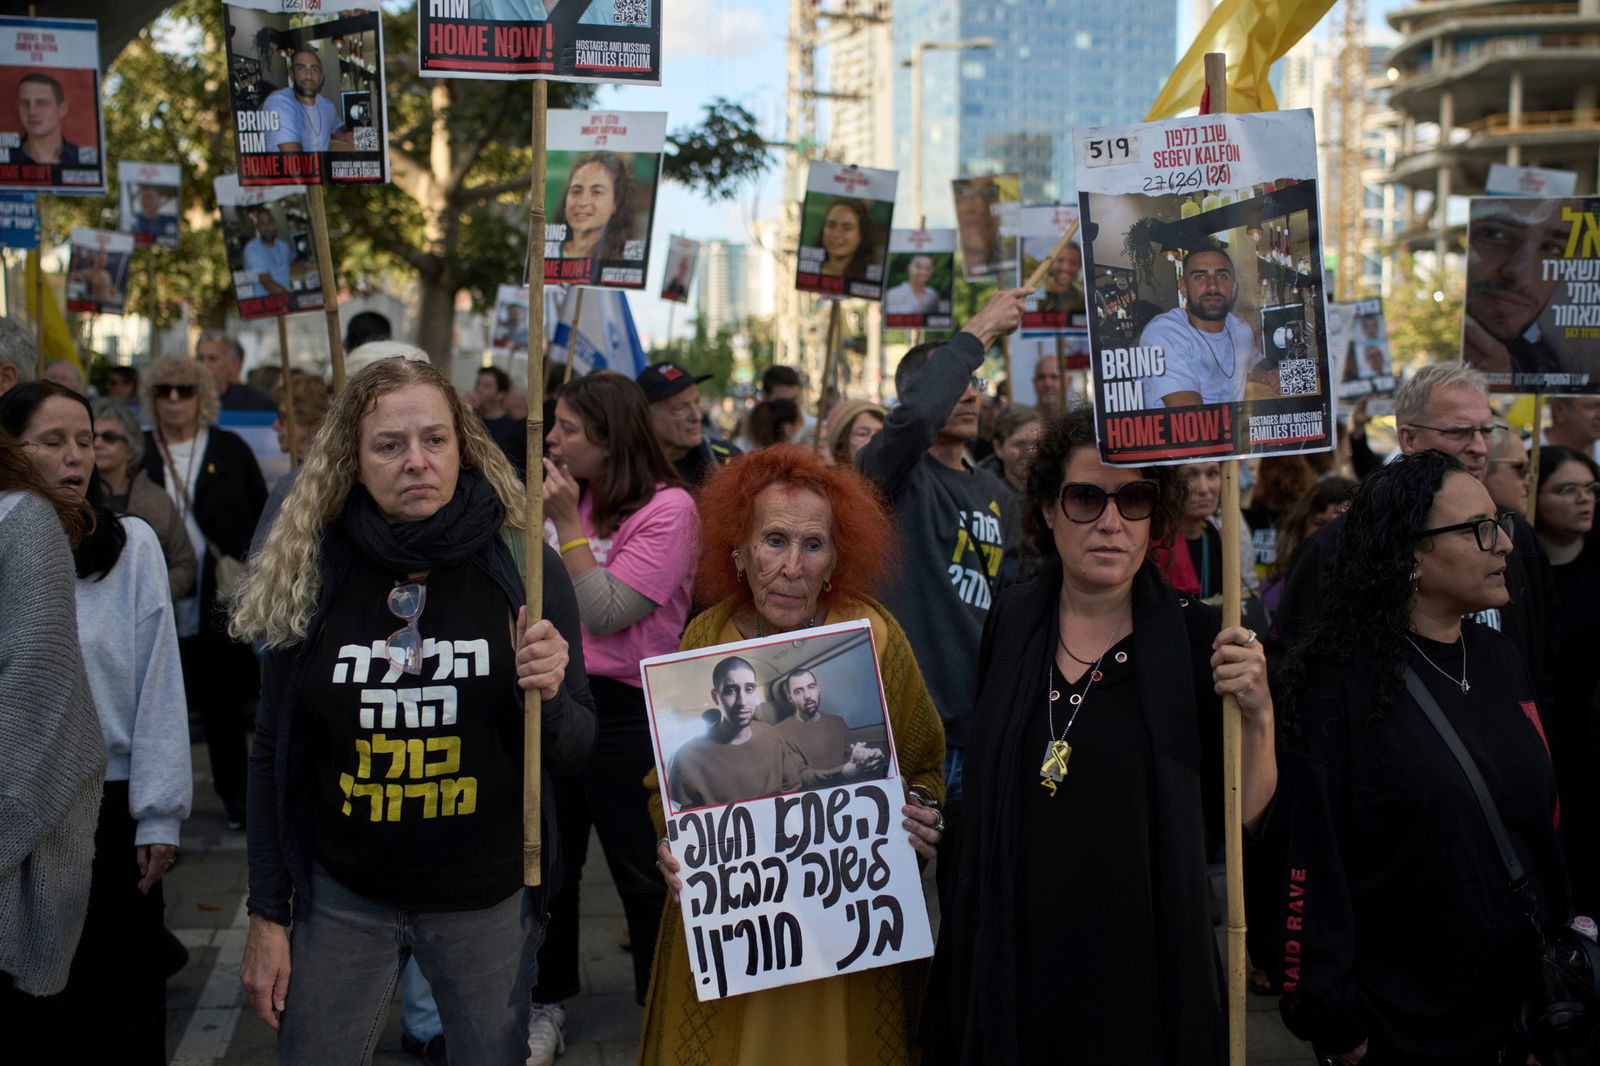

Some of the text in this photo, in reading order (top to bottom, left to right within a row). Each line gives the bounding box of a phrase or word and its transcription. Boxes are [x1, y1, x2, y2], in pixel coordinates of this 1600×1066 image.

[429, 0, 469, 19] HIM
[429, 23, 554, 58] HOME NOW!
[576, 39, 650, 53] HOSTAGES AND MISSING
[576, 50, 650, 69] FAMILIES FORUM
[237, 110, 280, 131] BRING
[239, 132, 266, 153] HIM
[1090, 138, 1130, 159] 519
[1164, 124, 1227, 150] שגב כלפון
[241, 152, 320, 176] HOME NOW!
[1153, 144, 1241, 169] SEGEV KALFON
[332, 168, 381, 178] FAMILIES FORUM
[1143, 176, 1167, 192] 27
[545, 224, 567, 241] RING
[1101, 345, 1166, 380] BRING
[1103, 379, 1144, 414] HIM
[1106, 404, 1232, 449] HOME NOW!
[1249, 411, 1322, 426] HOSTAGES AND MISSING
[1249, 421, 1323, 442] FAMILIES FORUM
[332, 637, 490, 683] הלילה
[359, 685, 457, 729] הזה
[355, 733, 461, 779] כולו
[339, 772, 477, 822] מרור!
[774, 785, 890, 862] השתא
[686, 837, 891, 918] לשנה הבאה
[1286, 868, 1307, 931] RAVE
[692, 894, 904, 997] בני חורין!
